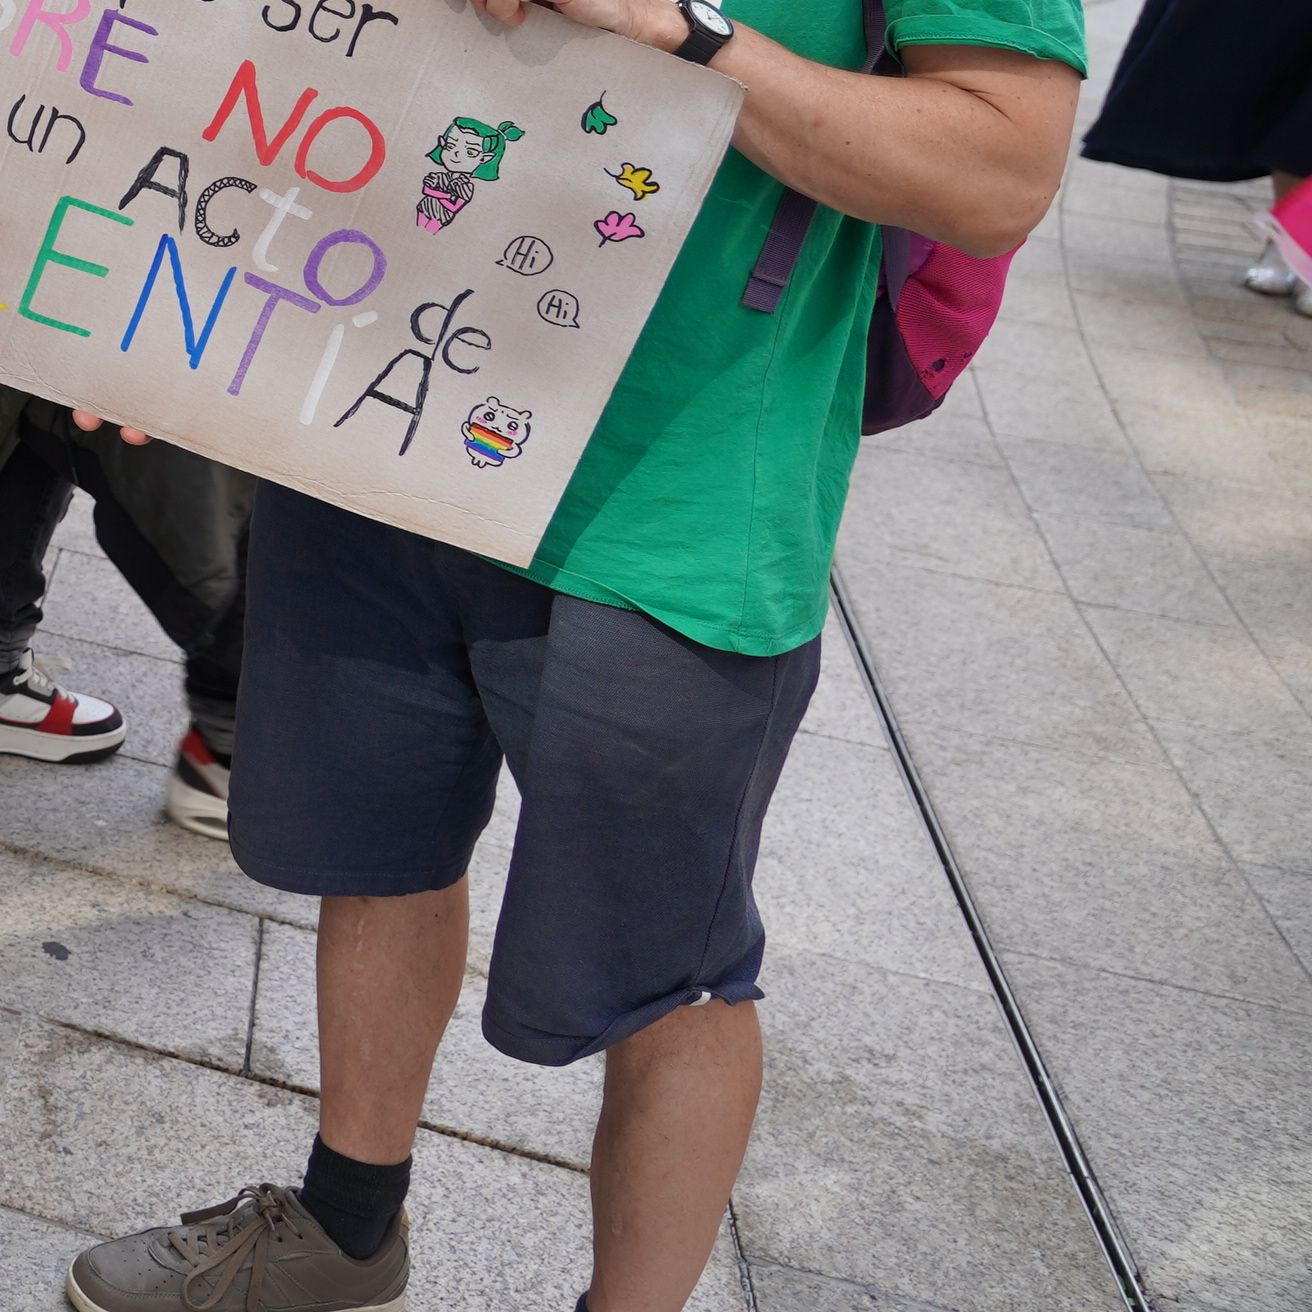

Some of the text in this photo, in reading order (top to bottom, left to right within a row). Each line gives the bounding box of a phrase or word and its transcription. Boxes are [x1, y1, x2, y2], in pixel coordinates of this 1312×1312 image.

[200, 58, 387, 194] NO
[5, 92, 88, 166] un
[408, 287, 494, 375] de
[510, 236, 539, 271] Hi
[545, 294, 570, 320] Hi
